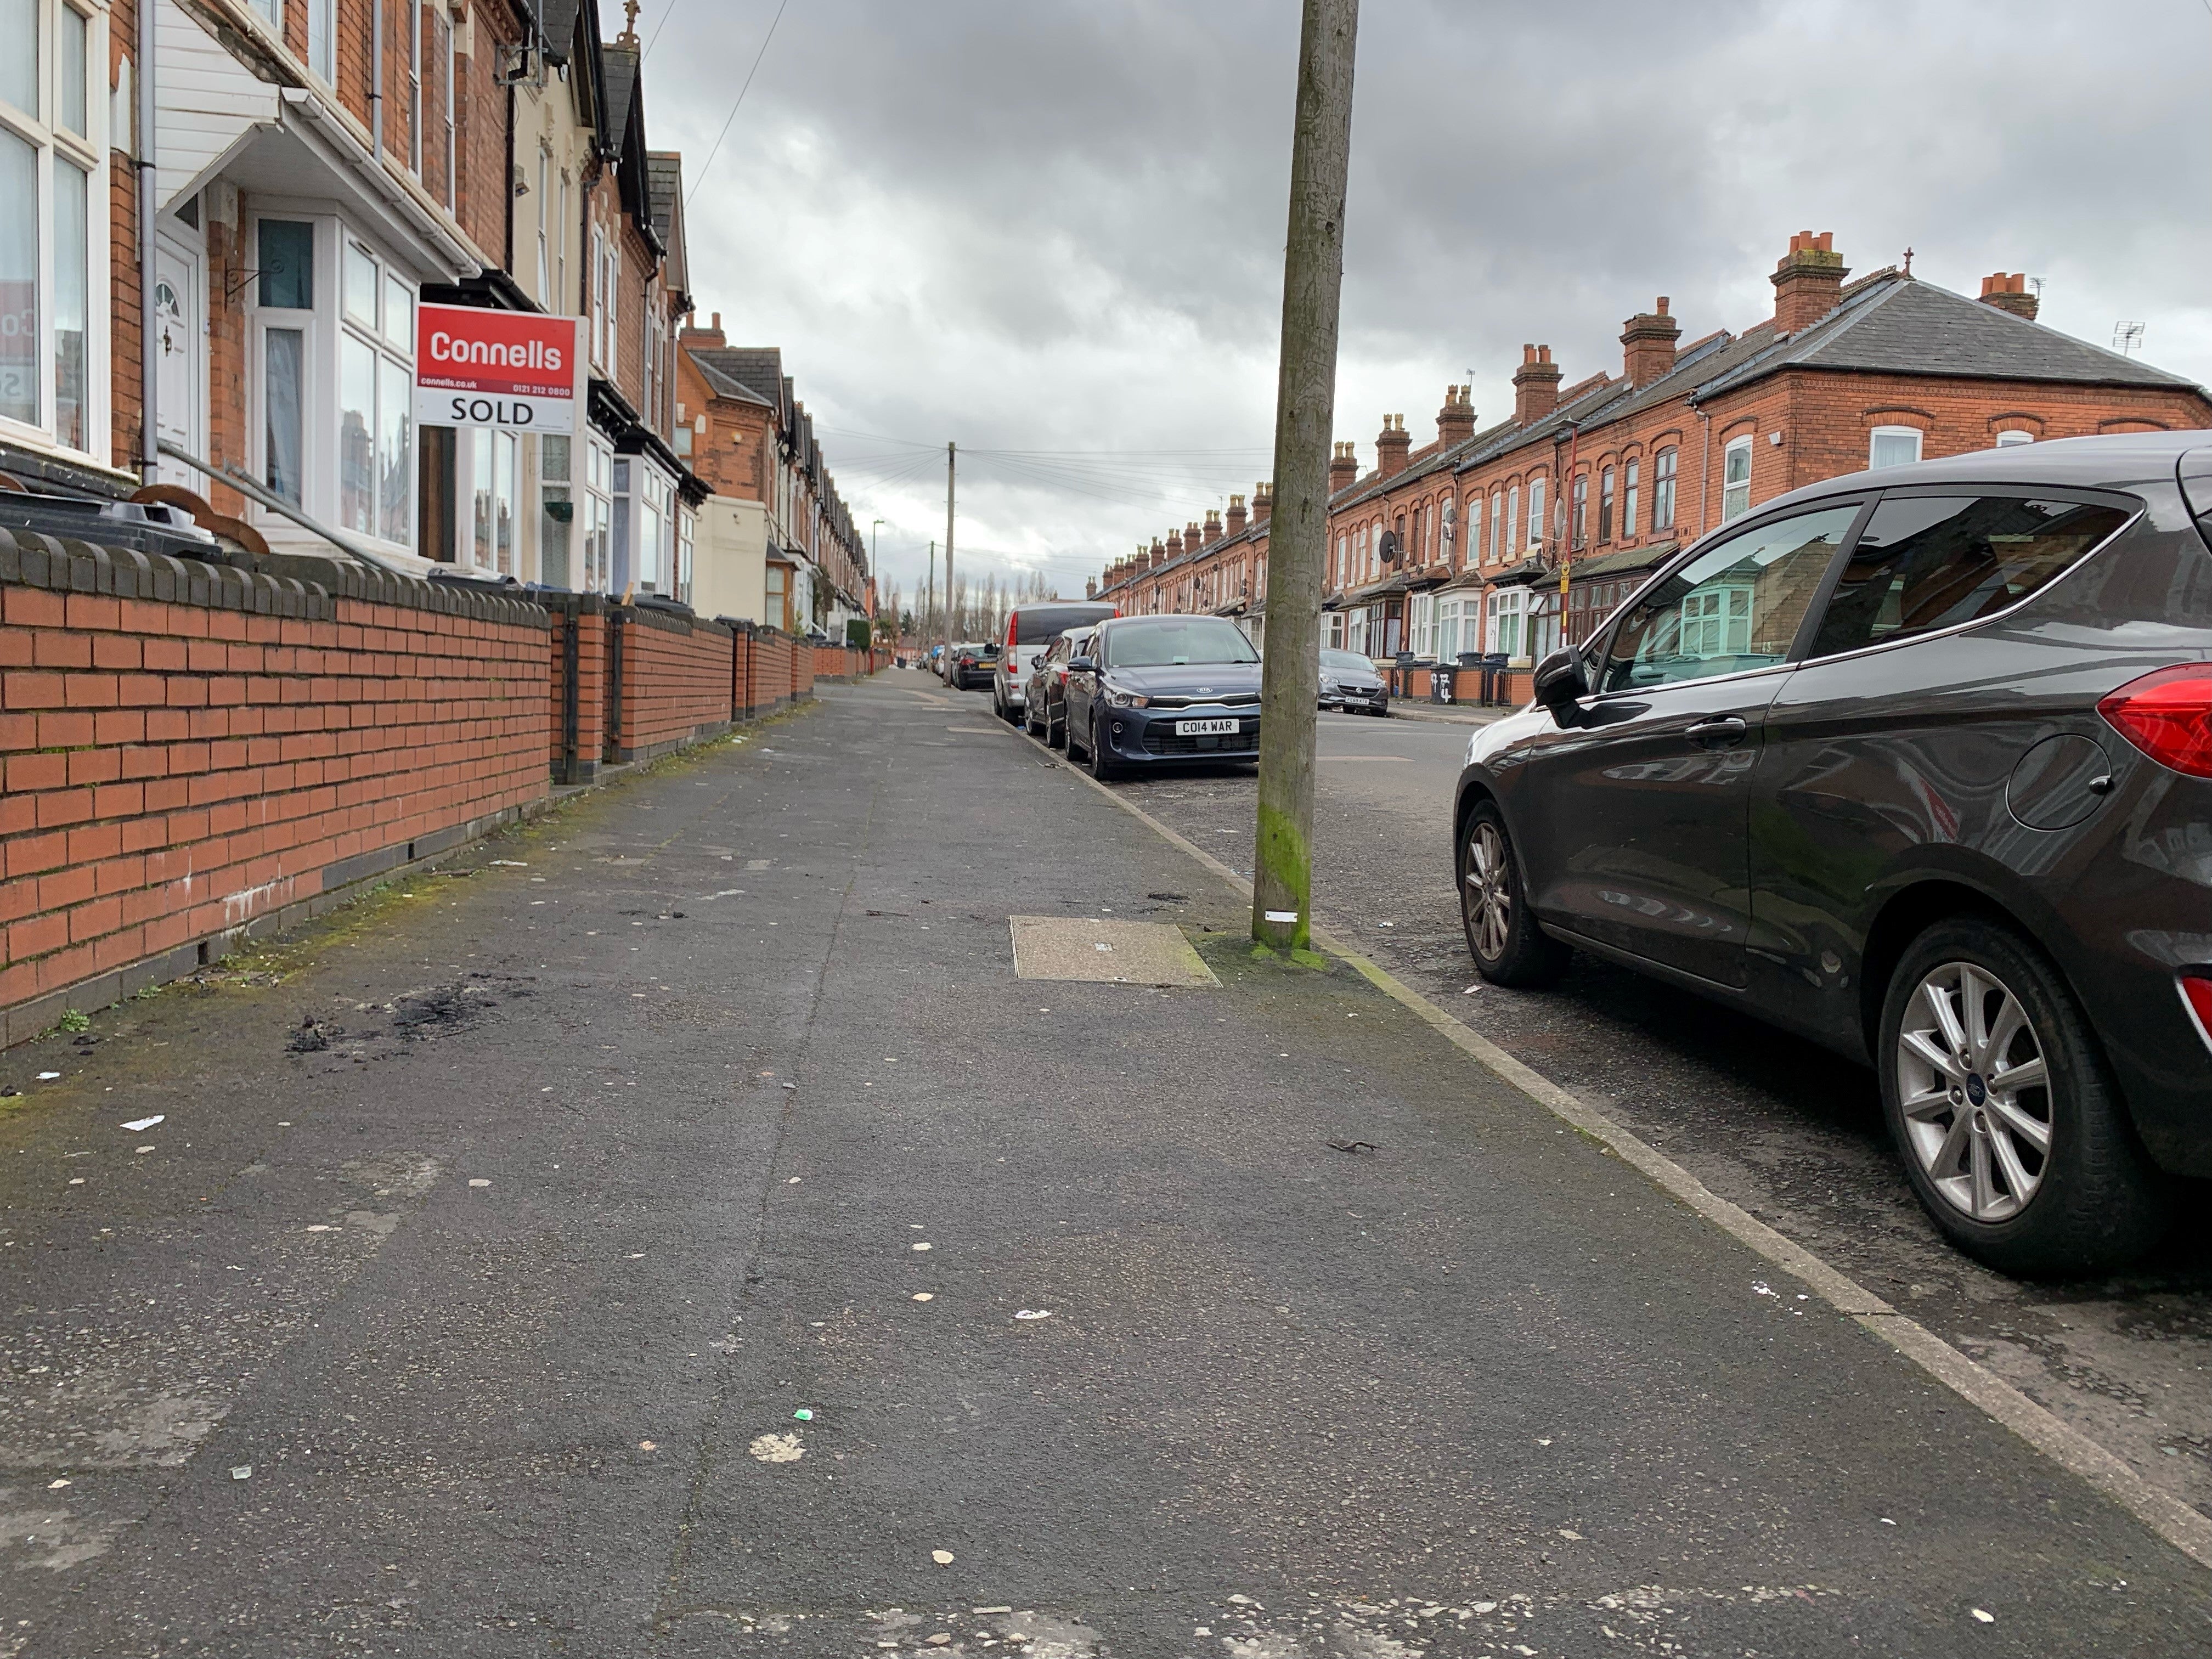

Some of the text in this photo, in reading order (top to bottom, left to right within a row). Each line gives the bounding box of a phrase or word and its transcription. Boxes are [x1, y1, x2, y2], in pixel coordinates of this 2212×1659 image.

[431, 331, 562, 371] Connells
[420, 377, 477, 389] connells.co.uk
[512, 384, 571, 396] 0121 212 0800
[451, 398, 533, 425] SOLD
[1183, 721, 1232, 732] CO14 WAR
